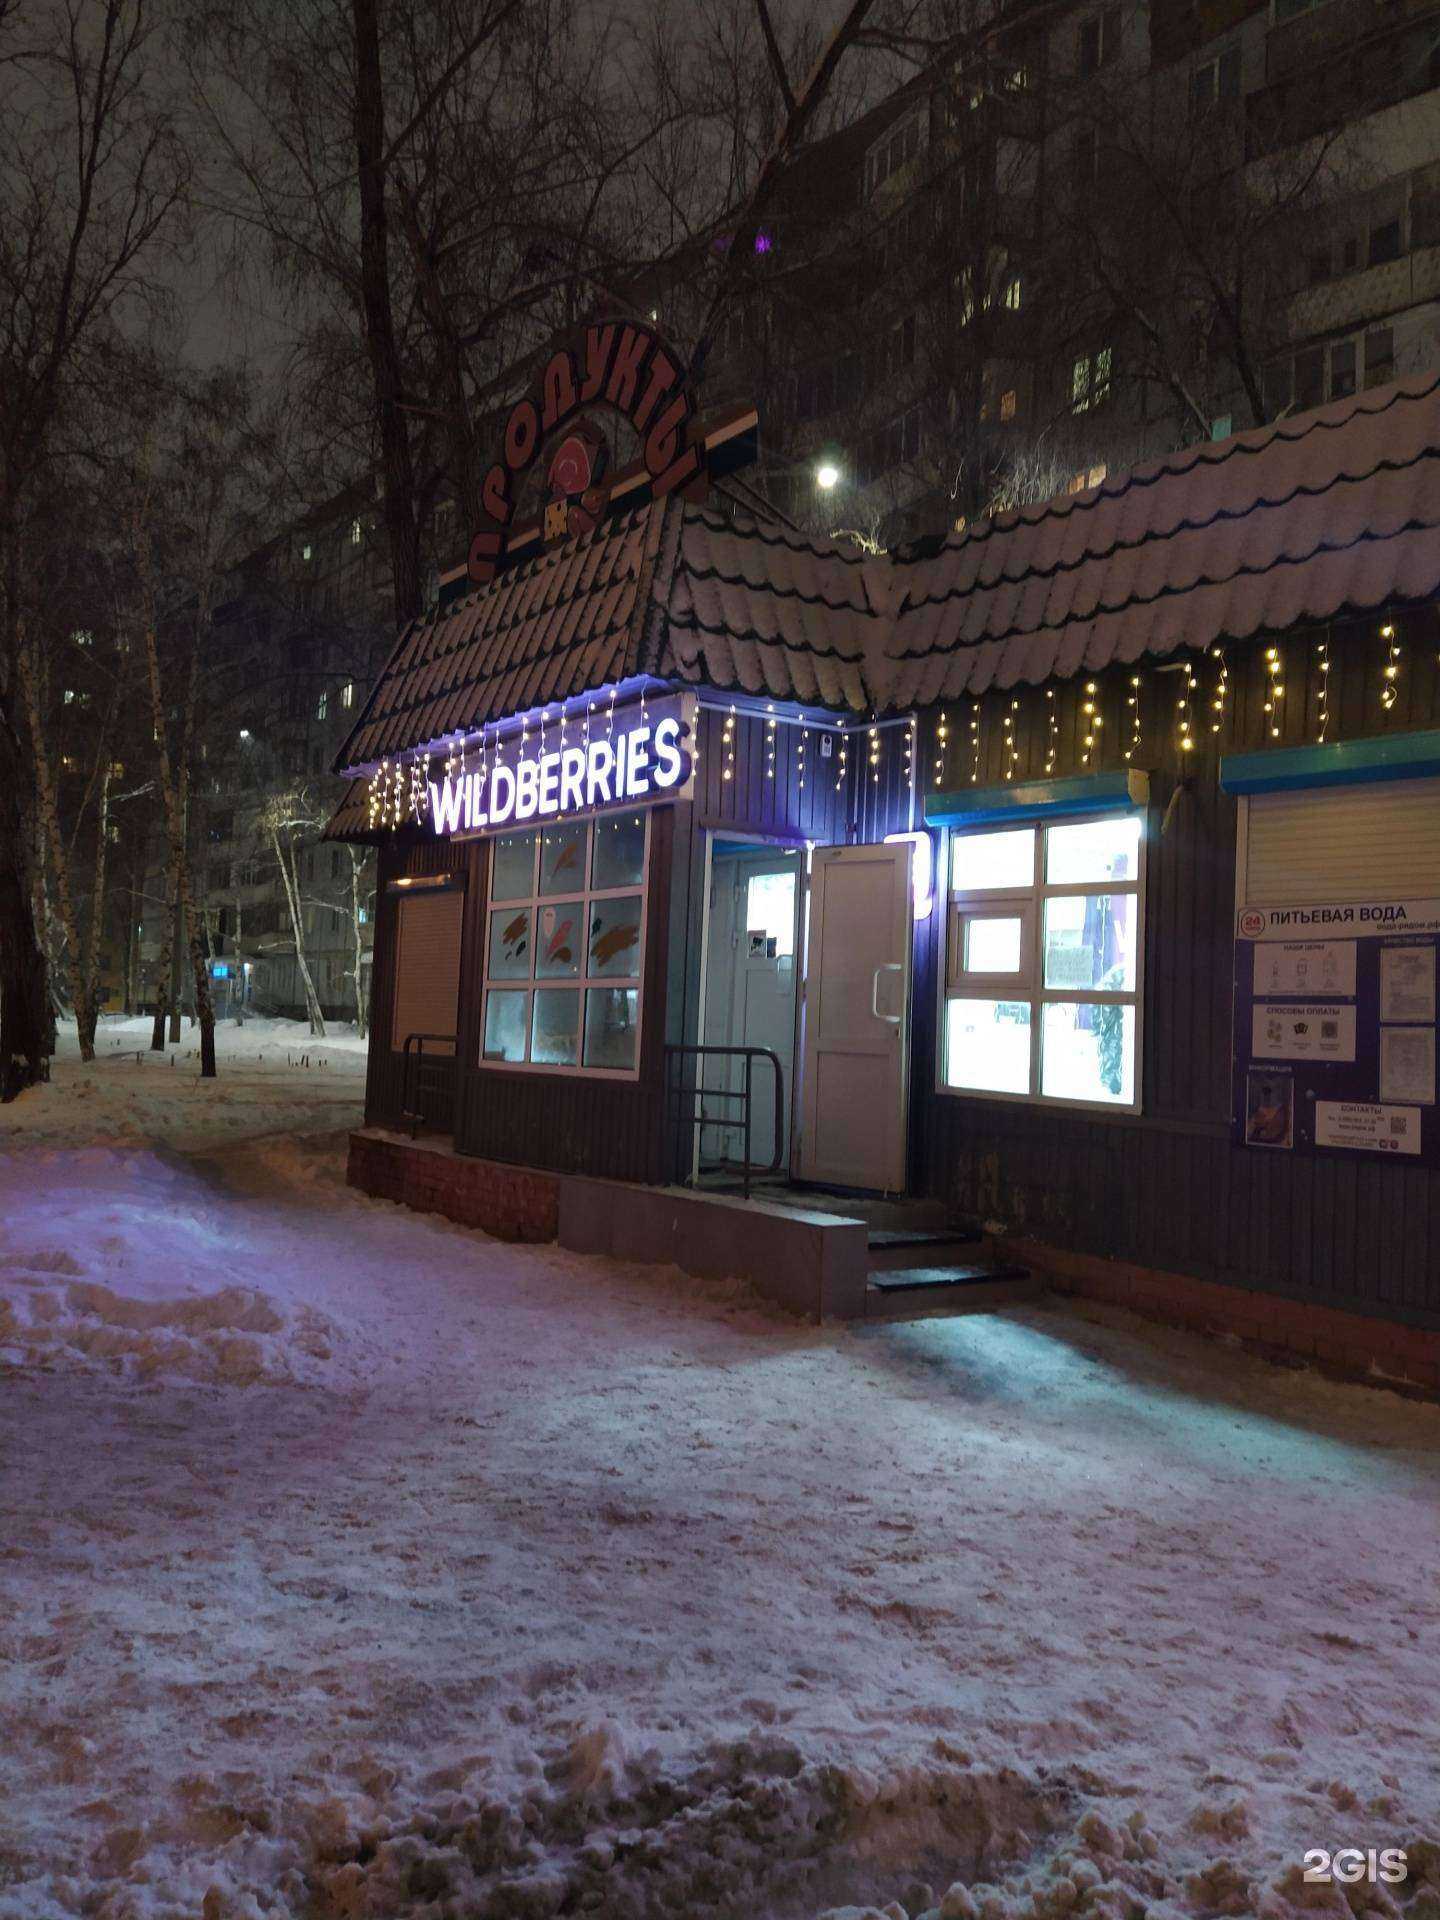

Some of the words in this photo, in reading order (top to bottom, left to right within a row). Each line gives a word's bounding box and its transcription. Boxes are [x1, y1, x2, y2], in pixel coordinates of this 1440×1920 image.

[468, 325, 702, 583] ПРОДУКТЫ
[429, 717, 686, 835] WILDBERRIES
[1270, 908, 1354, 925] ПИТЬЕВАЯ
[1360, 906, 1407, 922] ВОДА
